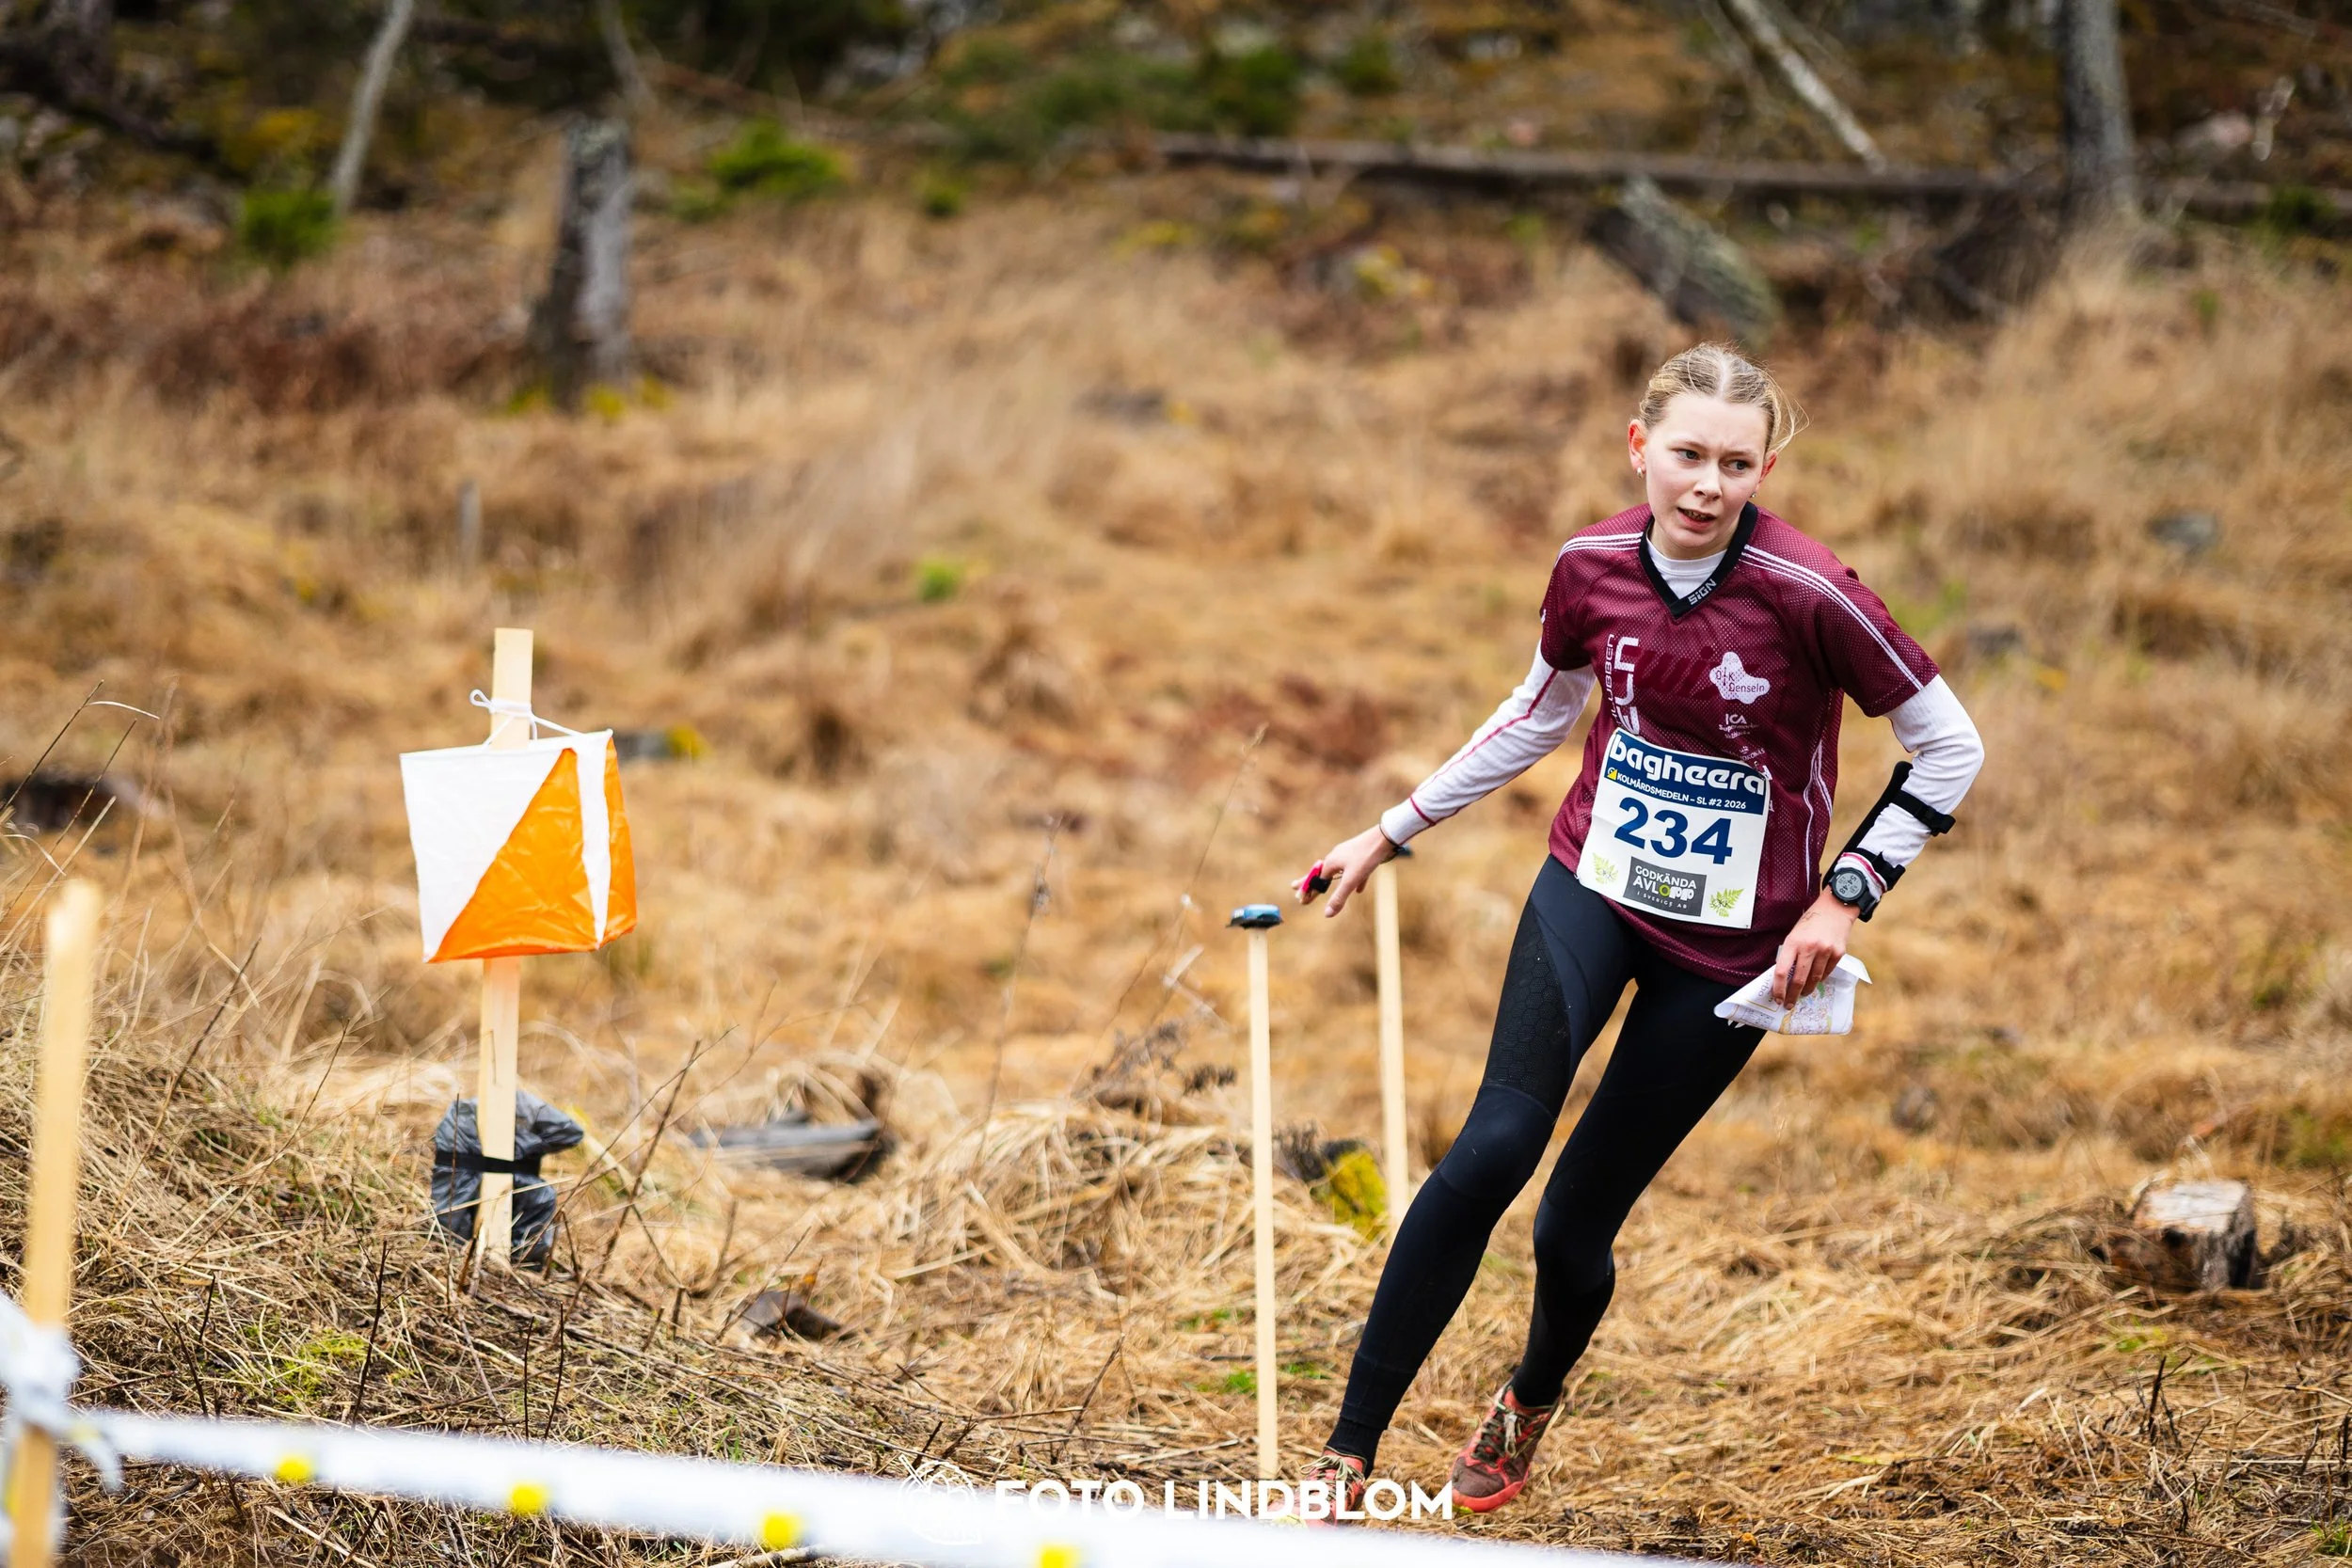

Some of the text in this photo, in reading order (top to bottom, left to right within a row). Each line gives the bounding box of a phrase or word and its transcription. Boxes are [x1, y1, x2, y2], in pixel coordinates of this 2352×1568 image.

[1724, 713, 1747, 725] ICA
[1609, 735, 1765, 796] bagheera
[1616, 773, 1690, 802] KOLMÅRDSMEDELN
[1696, 797, 1707, 805] SL
[1708, 798, 1723, 808] #2
[1724, 800, 1747, 810] 2026
[1614, 796, 1733, 865] 234
[1635, 864, 1697, 890] GODKÄNDA
